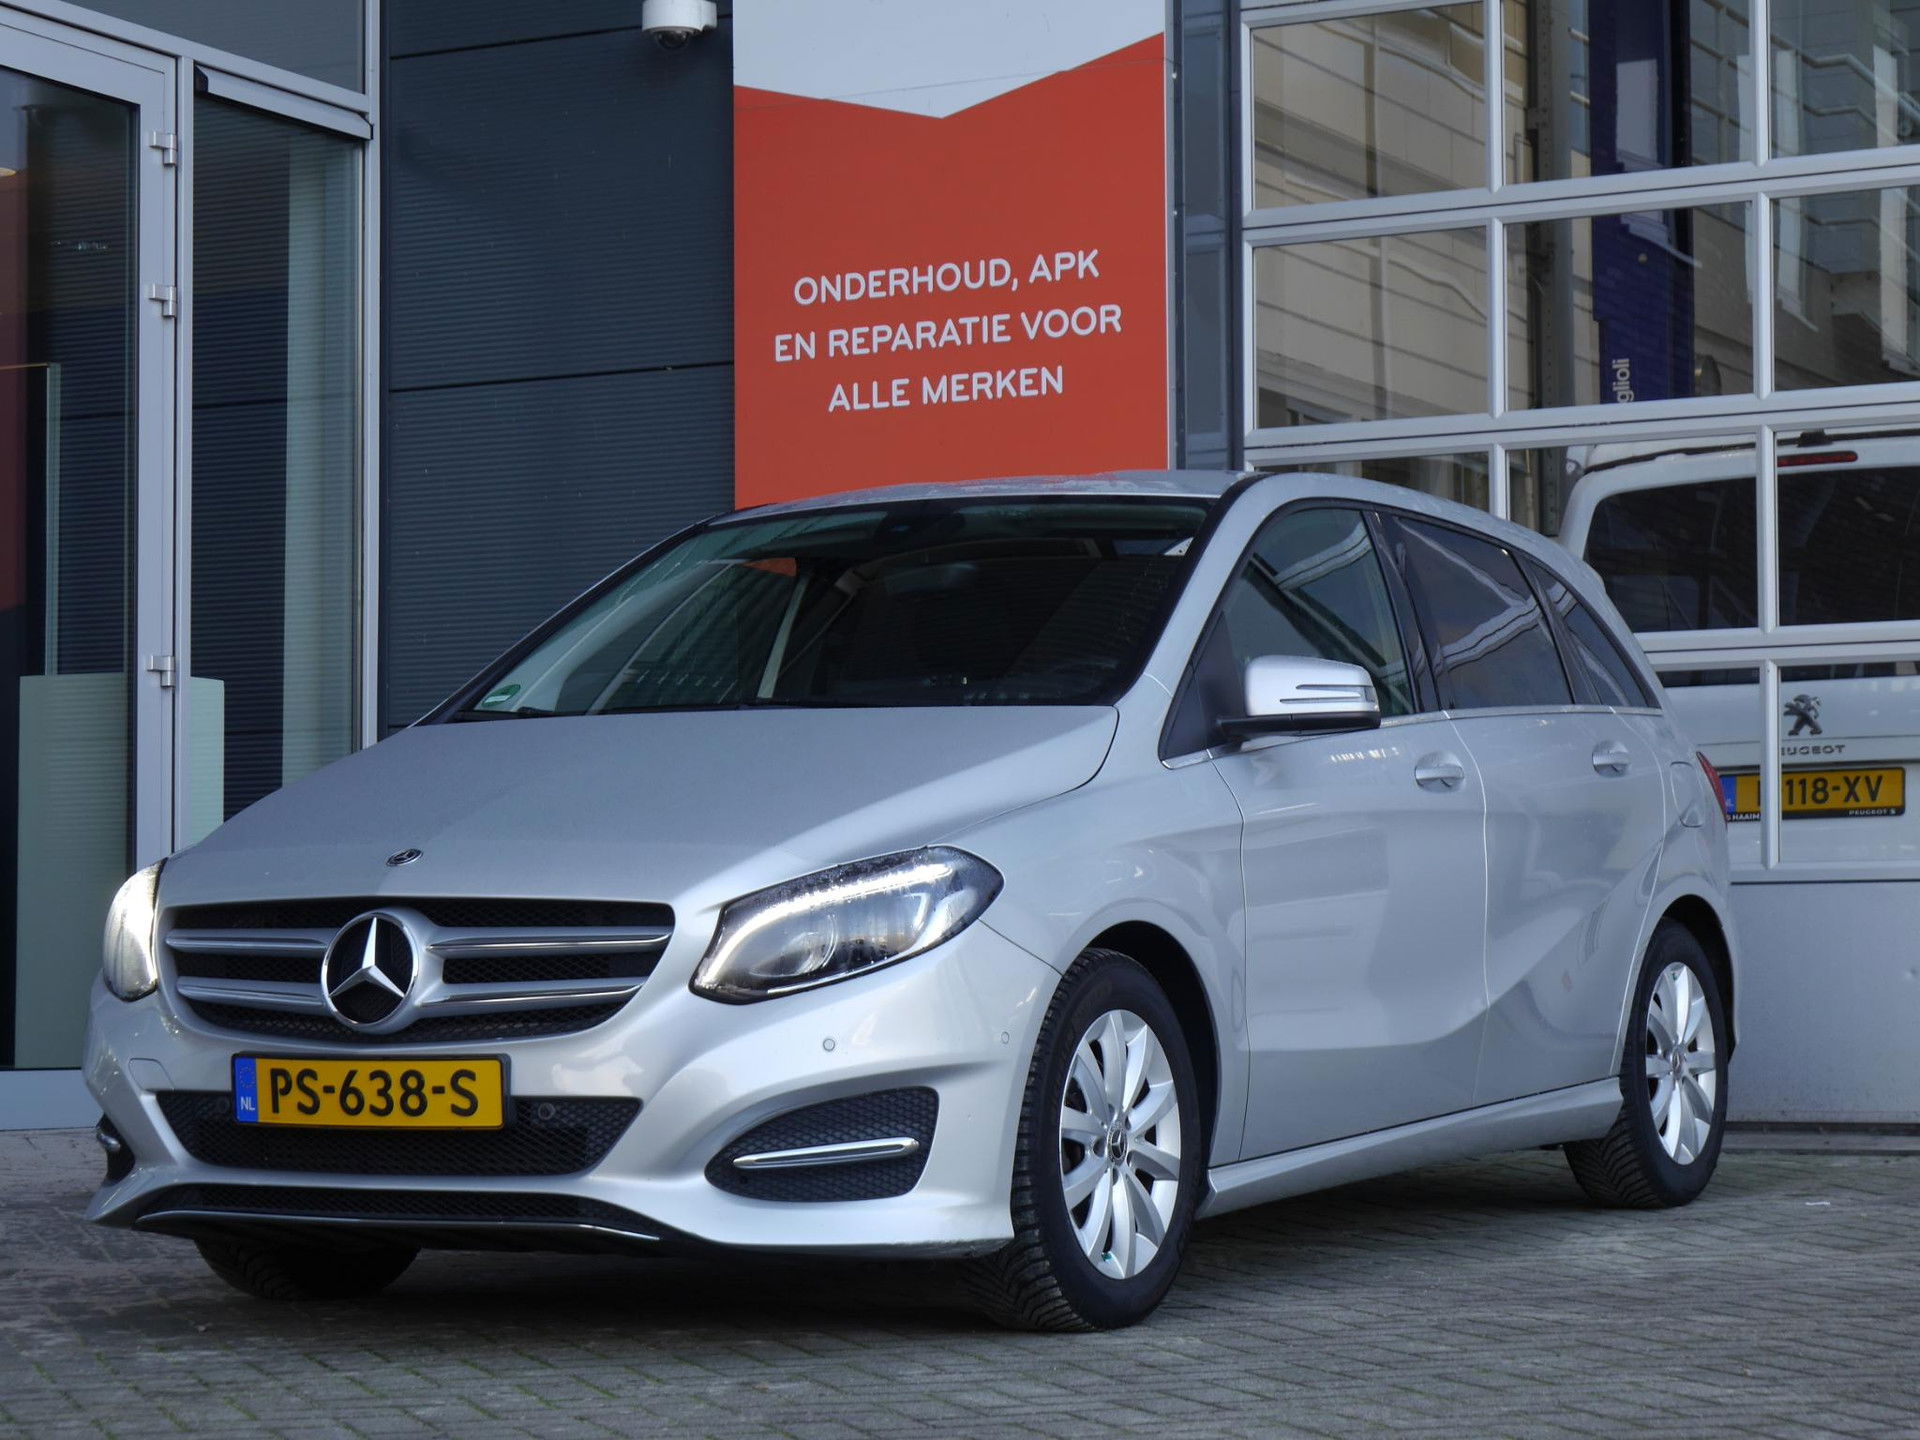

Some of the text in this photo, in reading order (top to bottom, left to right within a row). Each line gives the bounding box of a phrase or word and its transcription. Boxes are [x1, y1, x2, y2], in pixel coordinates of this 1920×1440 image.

[794, 249, 1100, 306] ONDERHOUD, APK
[774, 304, 1122, 363] EN REPARATIE VOOR
[828, 365, 1064, 413] ALLE MERKEN
[1757, 774, 1883, 807] 118-XV
[240, 1096, 255, 1111] NL
[269, 1067, 479, 1118] PS-638-S
